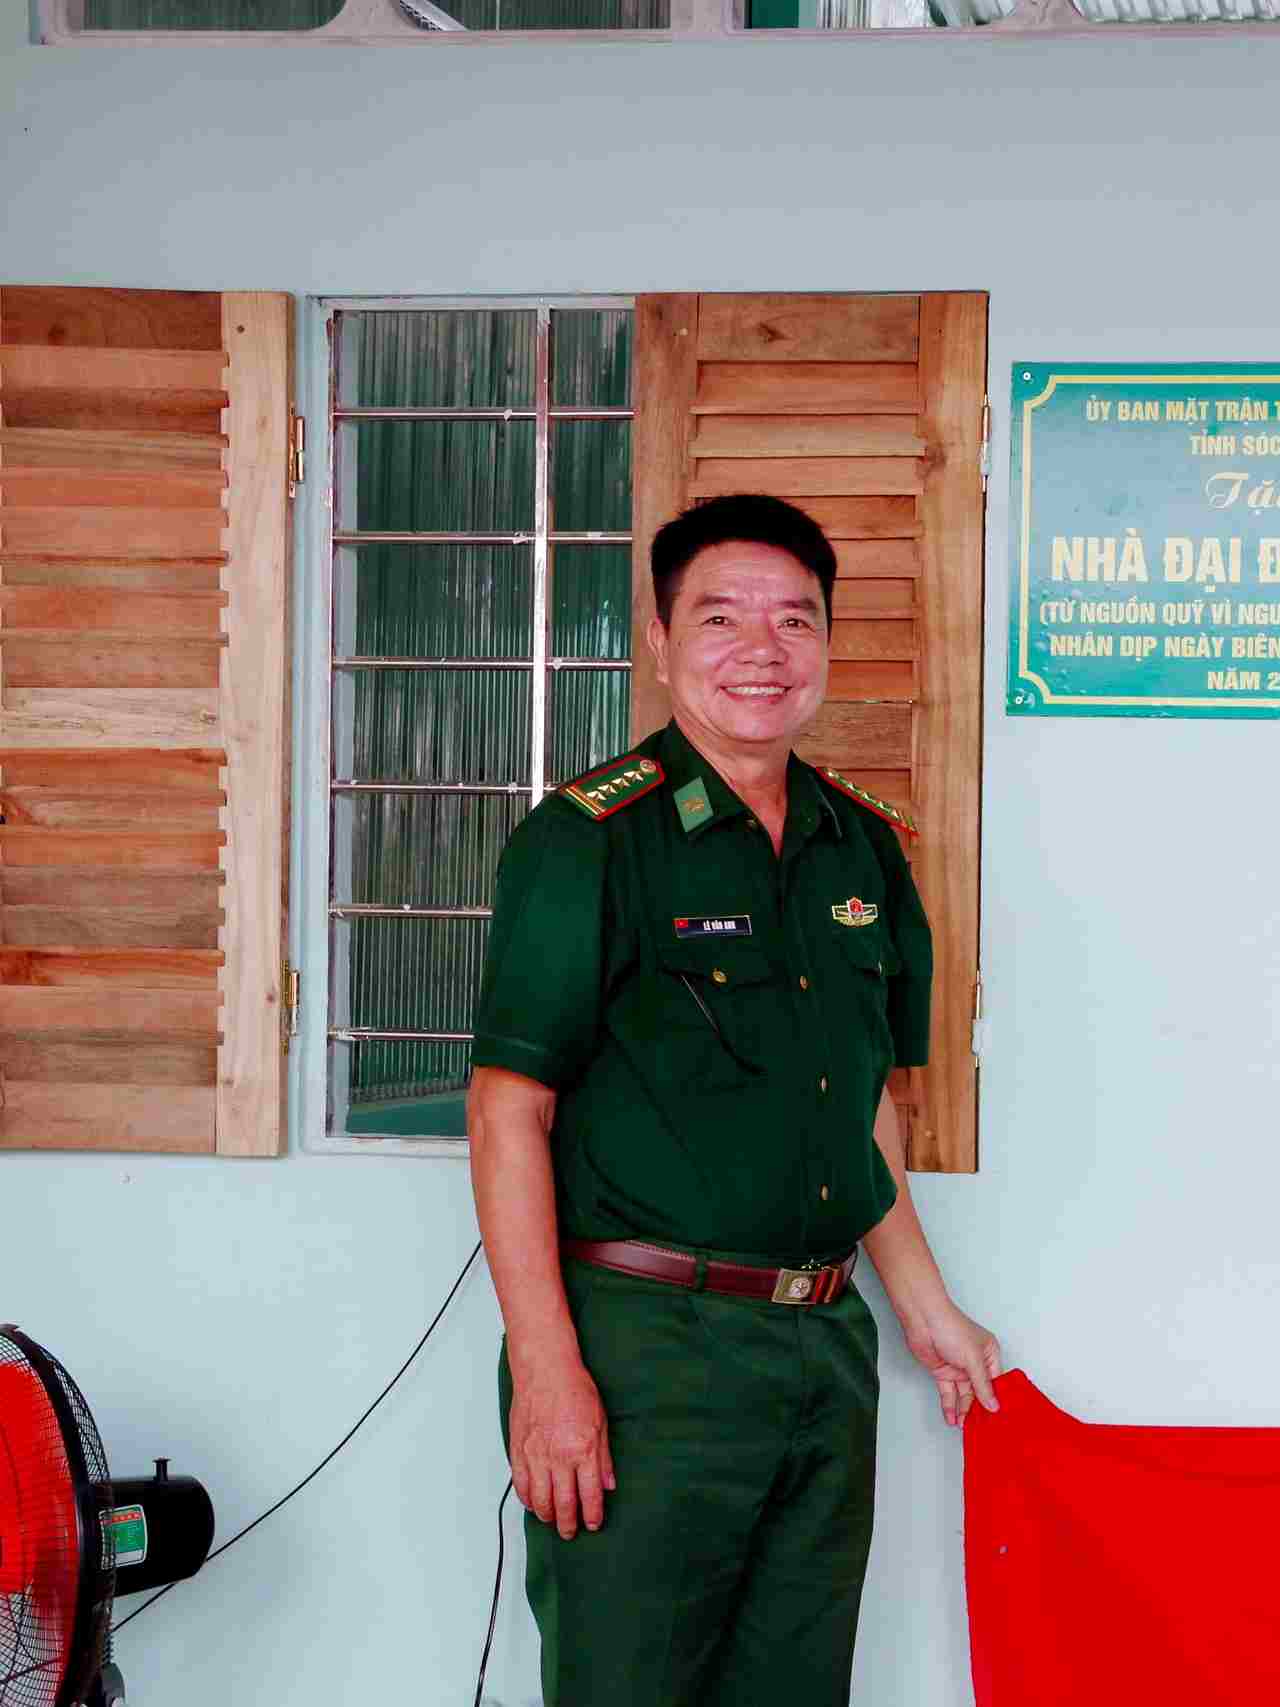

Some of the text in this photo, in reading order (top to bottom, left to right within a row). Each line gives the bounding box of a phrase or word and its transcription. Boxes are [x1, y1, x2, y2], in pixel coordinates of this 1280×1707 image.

[1087, 394, 1111, 421] ỦY
[1118, 400, 1160, 421] BAN
[1166, 398, 1209, 425] MẶT
[1215, 396, 1268, 425] TRẬN
[1189, 429, 1235, 455] TỈNH
[1052, 528, 1148, 582] NHÀ
[1163, 537, 1242, 592] ĐẠI
[1040, 598, 1076, 626] (TỪ
[1080, 595, 1156, 624] NGUỒN
[1163, 599, 1205, 626] QUỸ
[1211, 599, 1232, 625] VÌ
[1050, 631, 1112, 656] NHÂN
[1120, 636, 1157, 662] DỊP
[1164, 632, 1224, 657] NGÀY
[1208, 667, 1260, 690] NĂM
